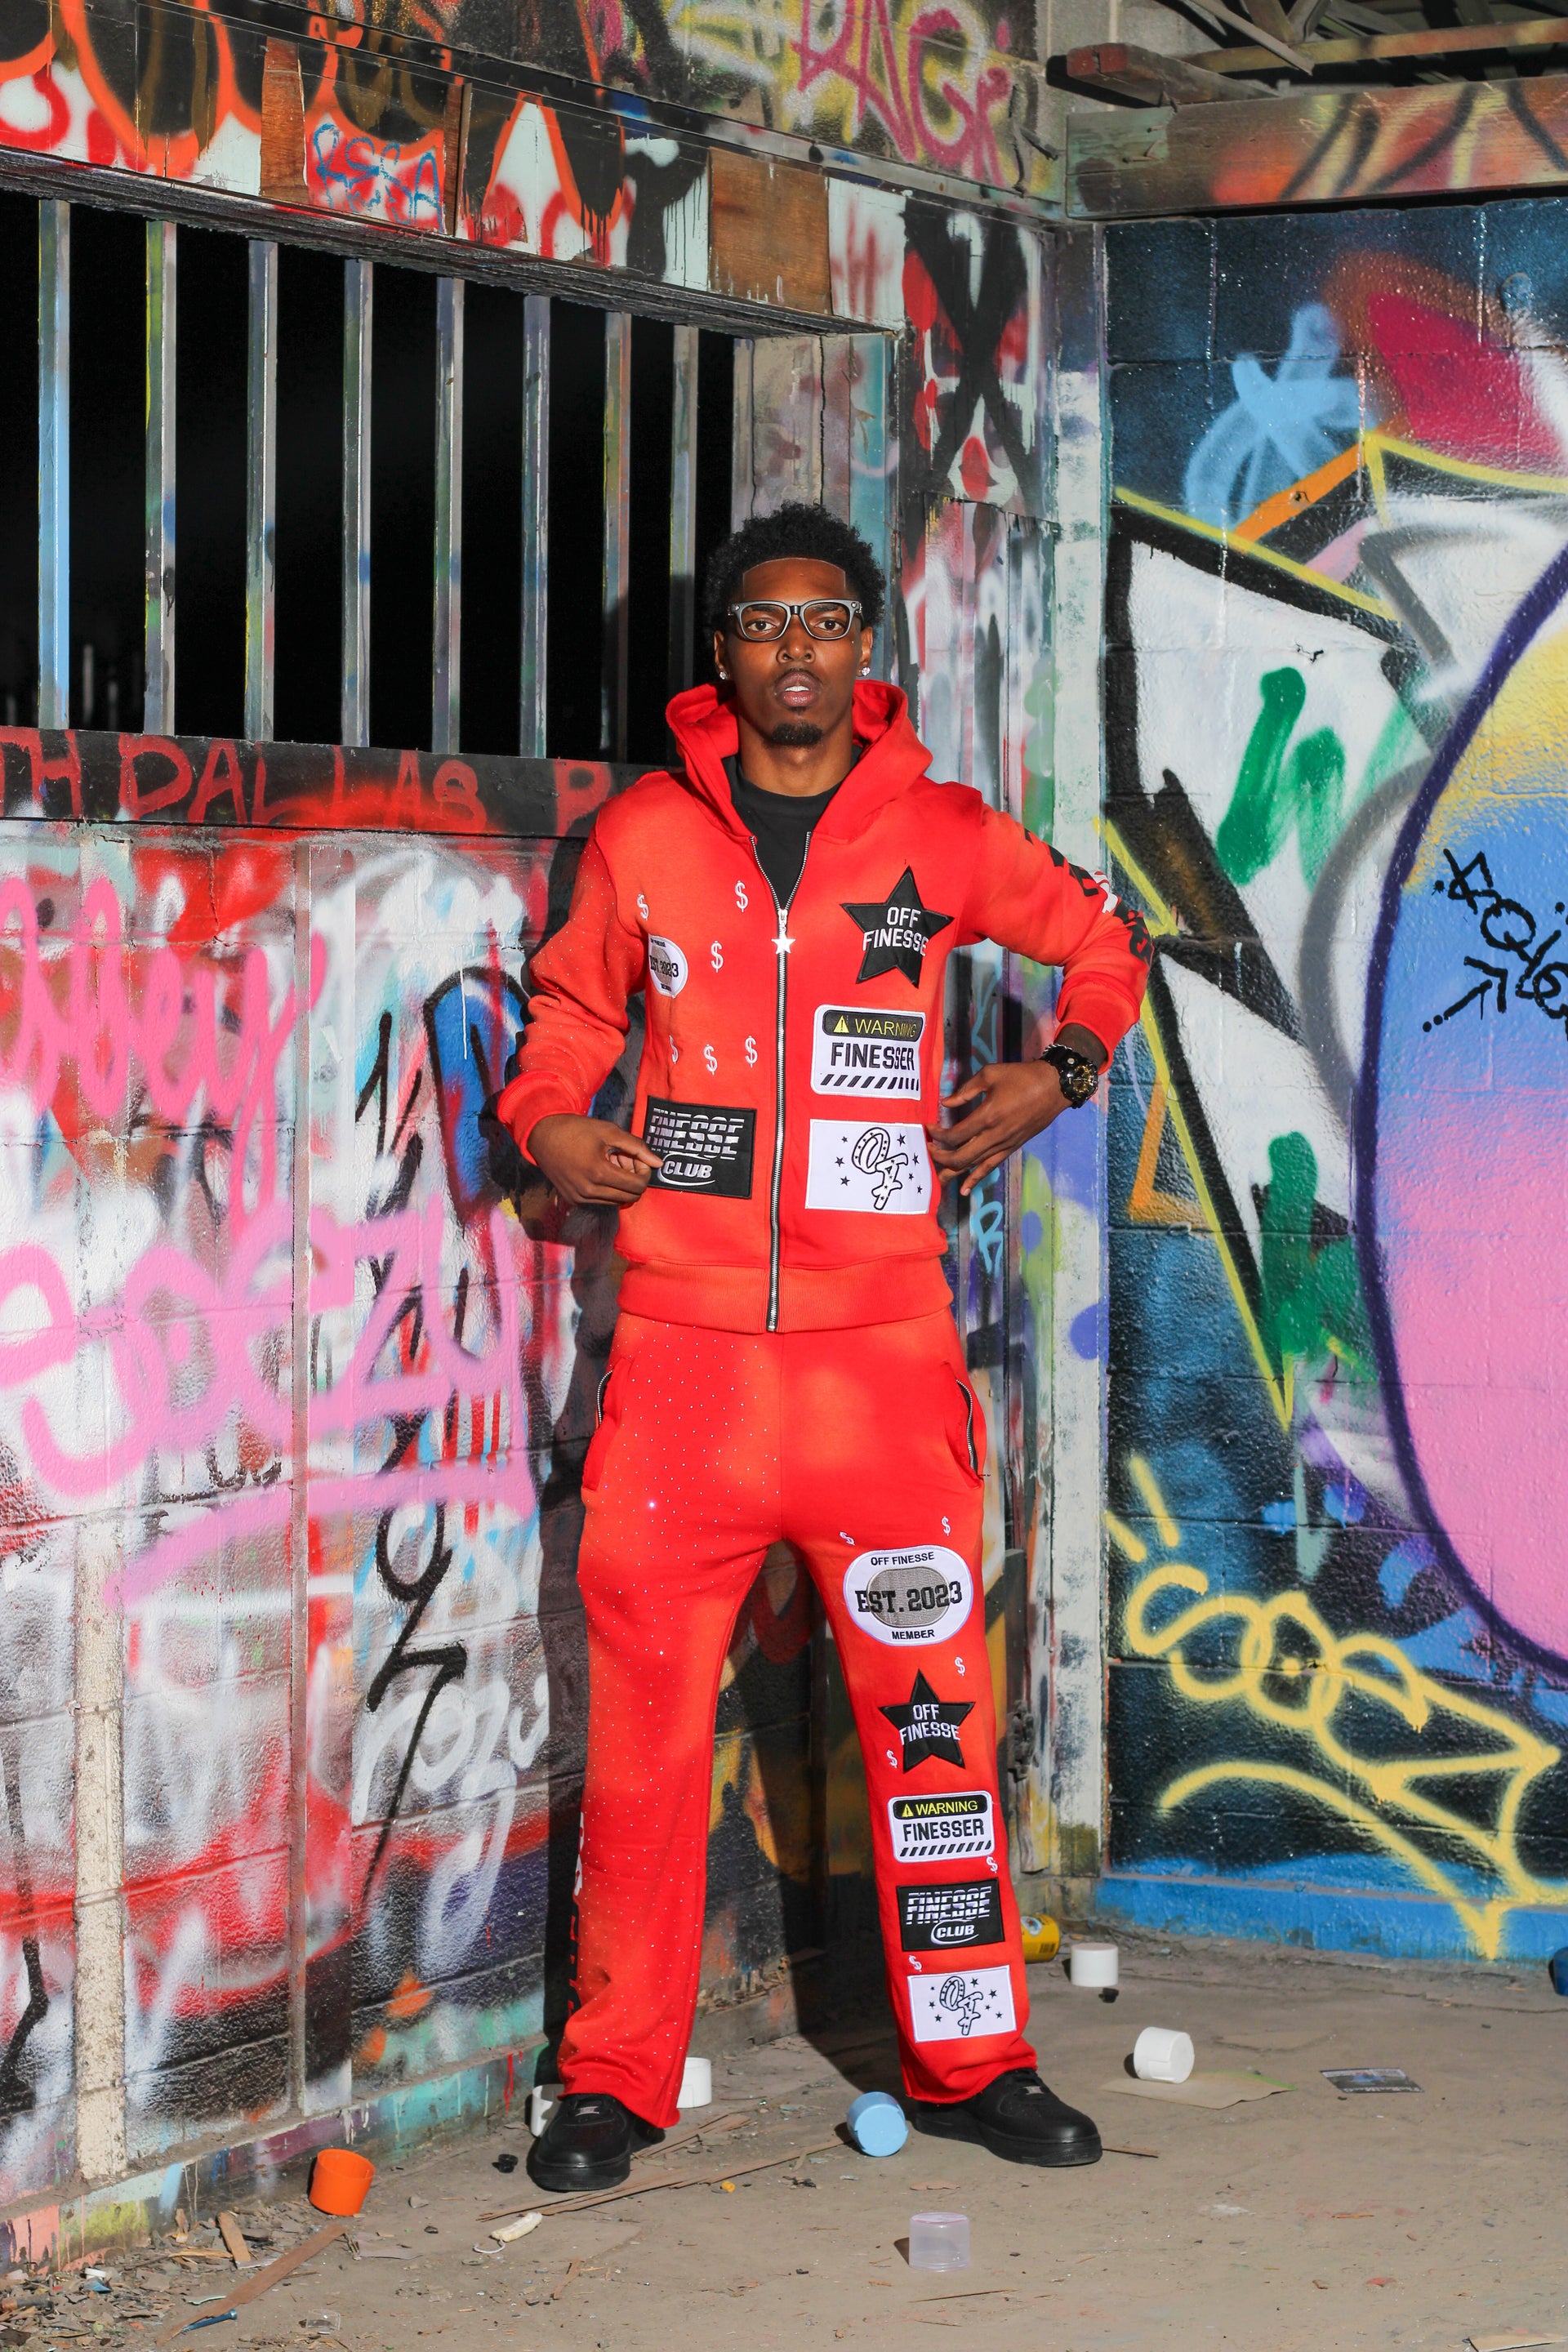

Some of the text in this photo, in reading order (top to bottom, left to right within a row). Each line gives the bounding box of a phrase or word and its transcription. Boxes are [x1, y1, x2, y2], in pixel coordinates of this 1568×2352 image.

[886, 906, 921, 928] OFF
[862, 928, 929, 956] FINESSE
[855, 1018, 917, 1038] WARNING
[831, 1042, 915, 1071] FINESSER
[662, 1160, 713, 1178] CLUB
[871, 1552, 935, 1566] OFF FINESSE
[855, 1580, 962, 1613] EST. 2023
[892, 1629, 935, 1640] MEMBER
[912, 1704, 939, 1720] OFF
[898, 1722, 961, 1745] FINESSE
[915, 1800, 978, 1816] WARNING
[902, 1819, 985, 1842] FINESSER
[936, 1923, 975, 1938] CLUB
